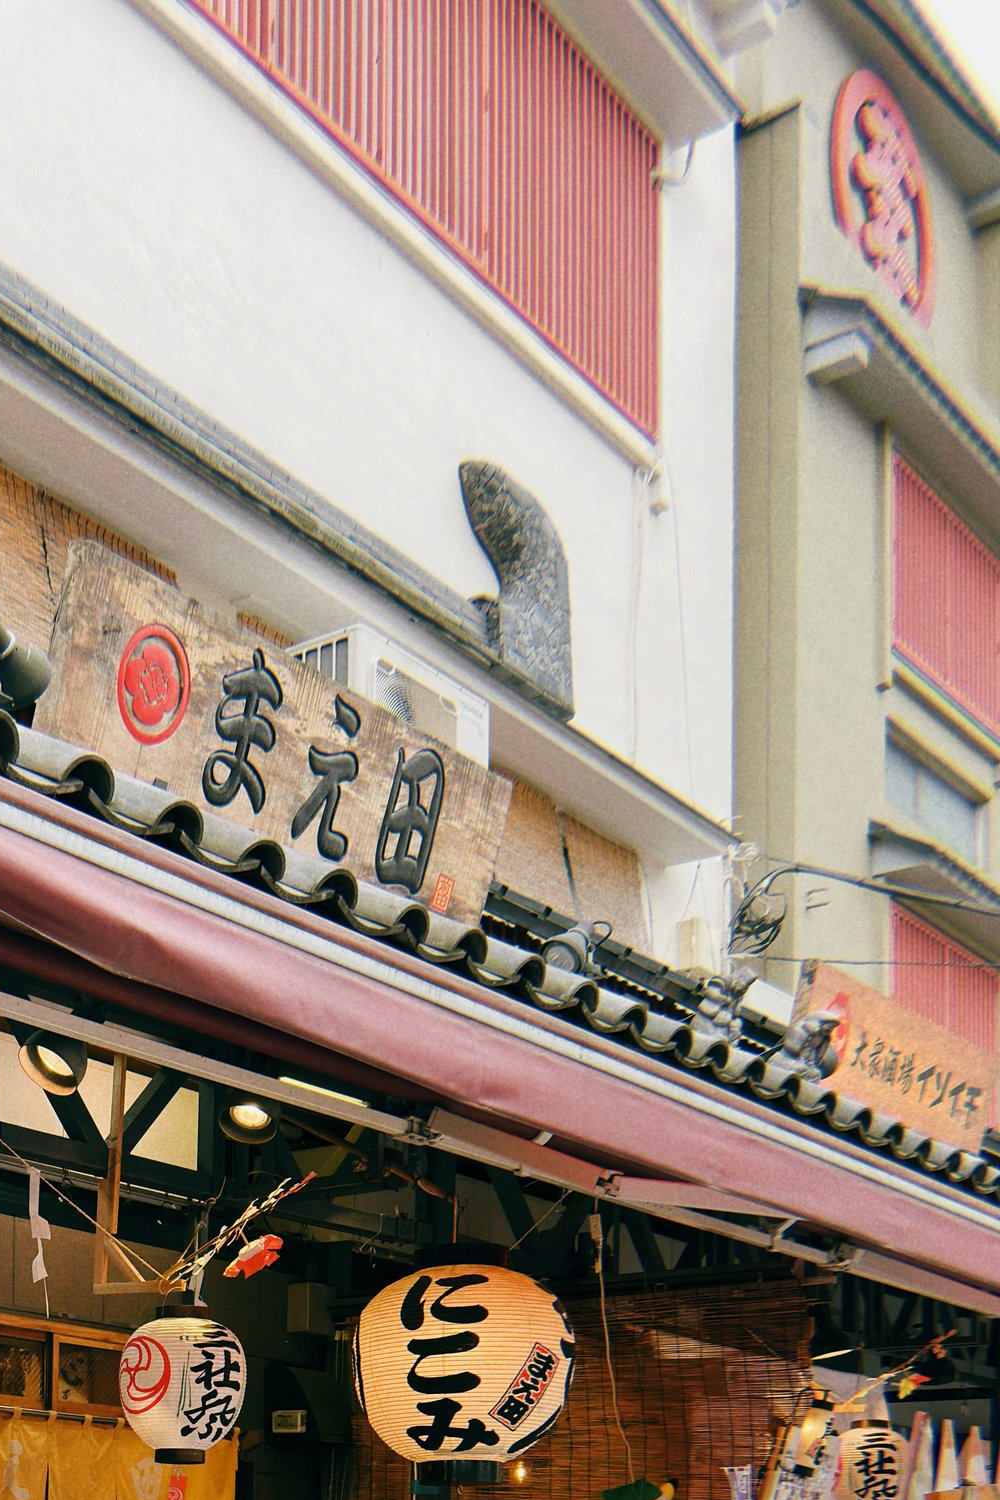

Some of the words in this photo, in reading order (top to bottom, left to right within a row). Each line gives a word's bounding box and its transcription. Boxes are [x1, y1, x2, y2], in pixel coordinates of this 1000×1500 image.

[181, 1323, 241, 1443] 三社祭
[400, 1273, 500, 1452] にこみ
